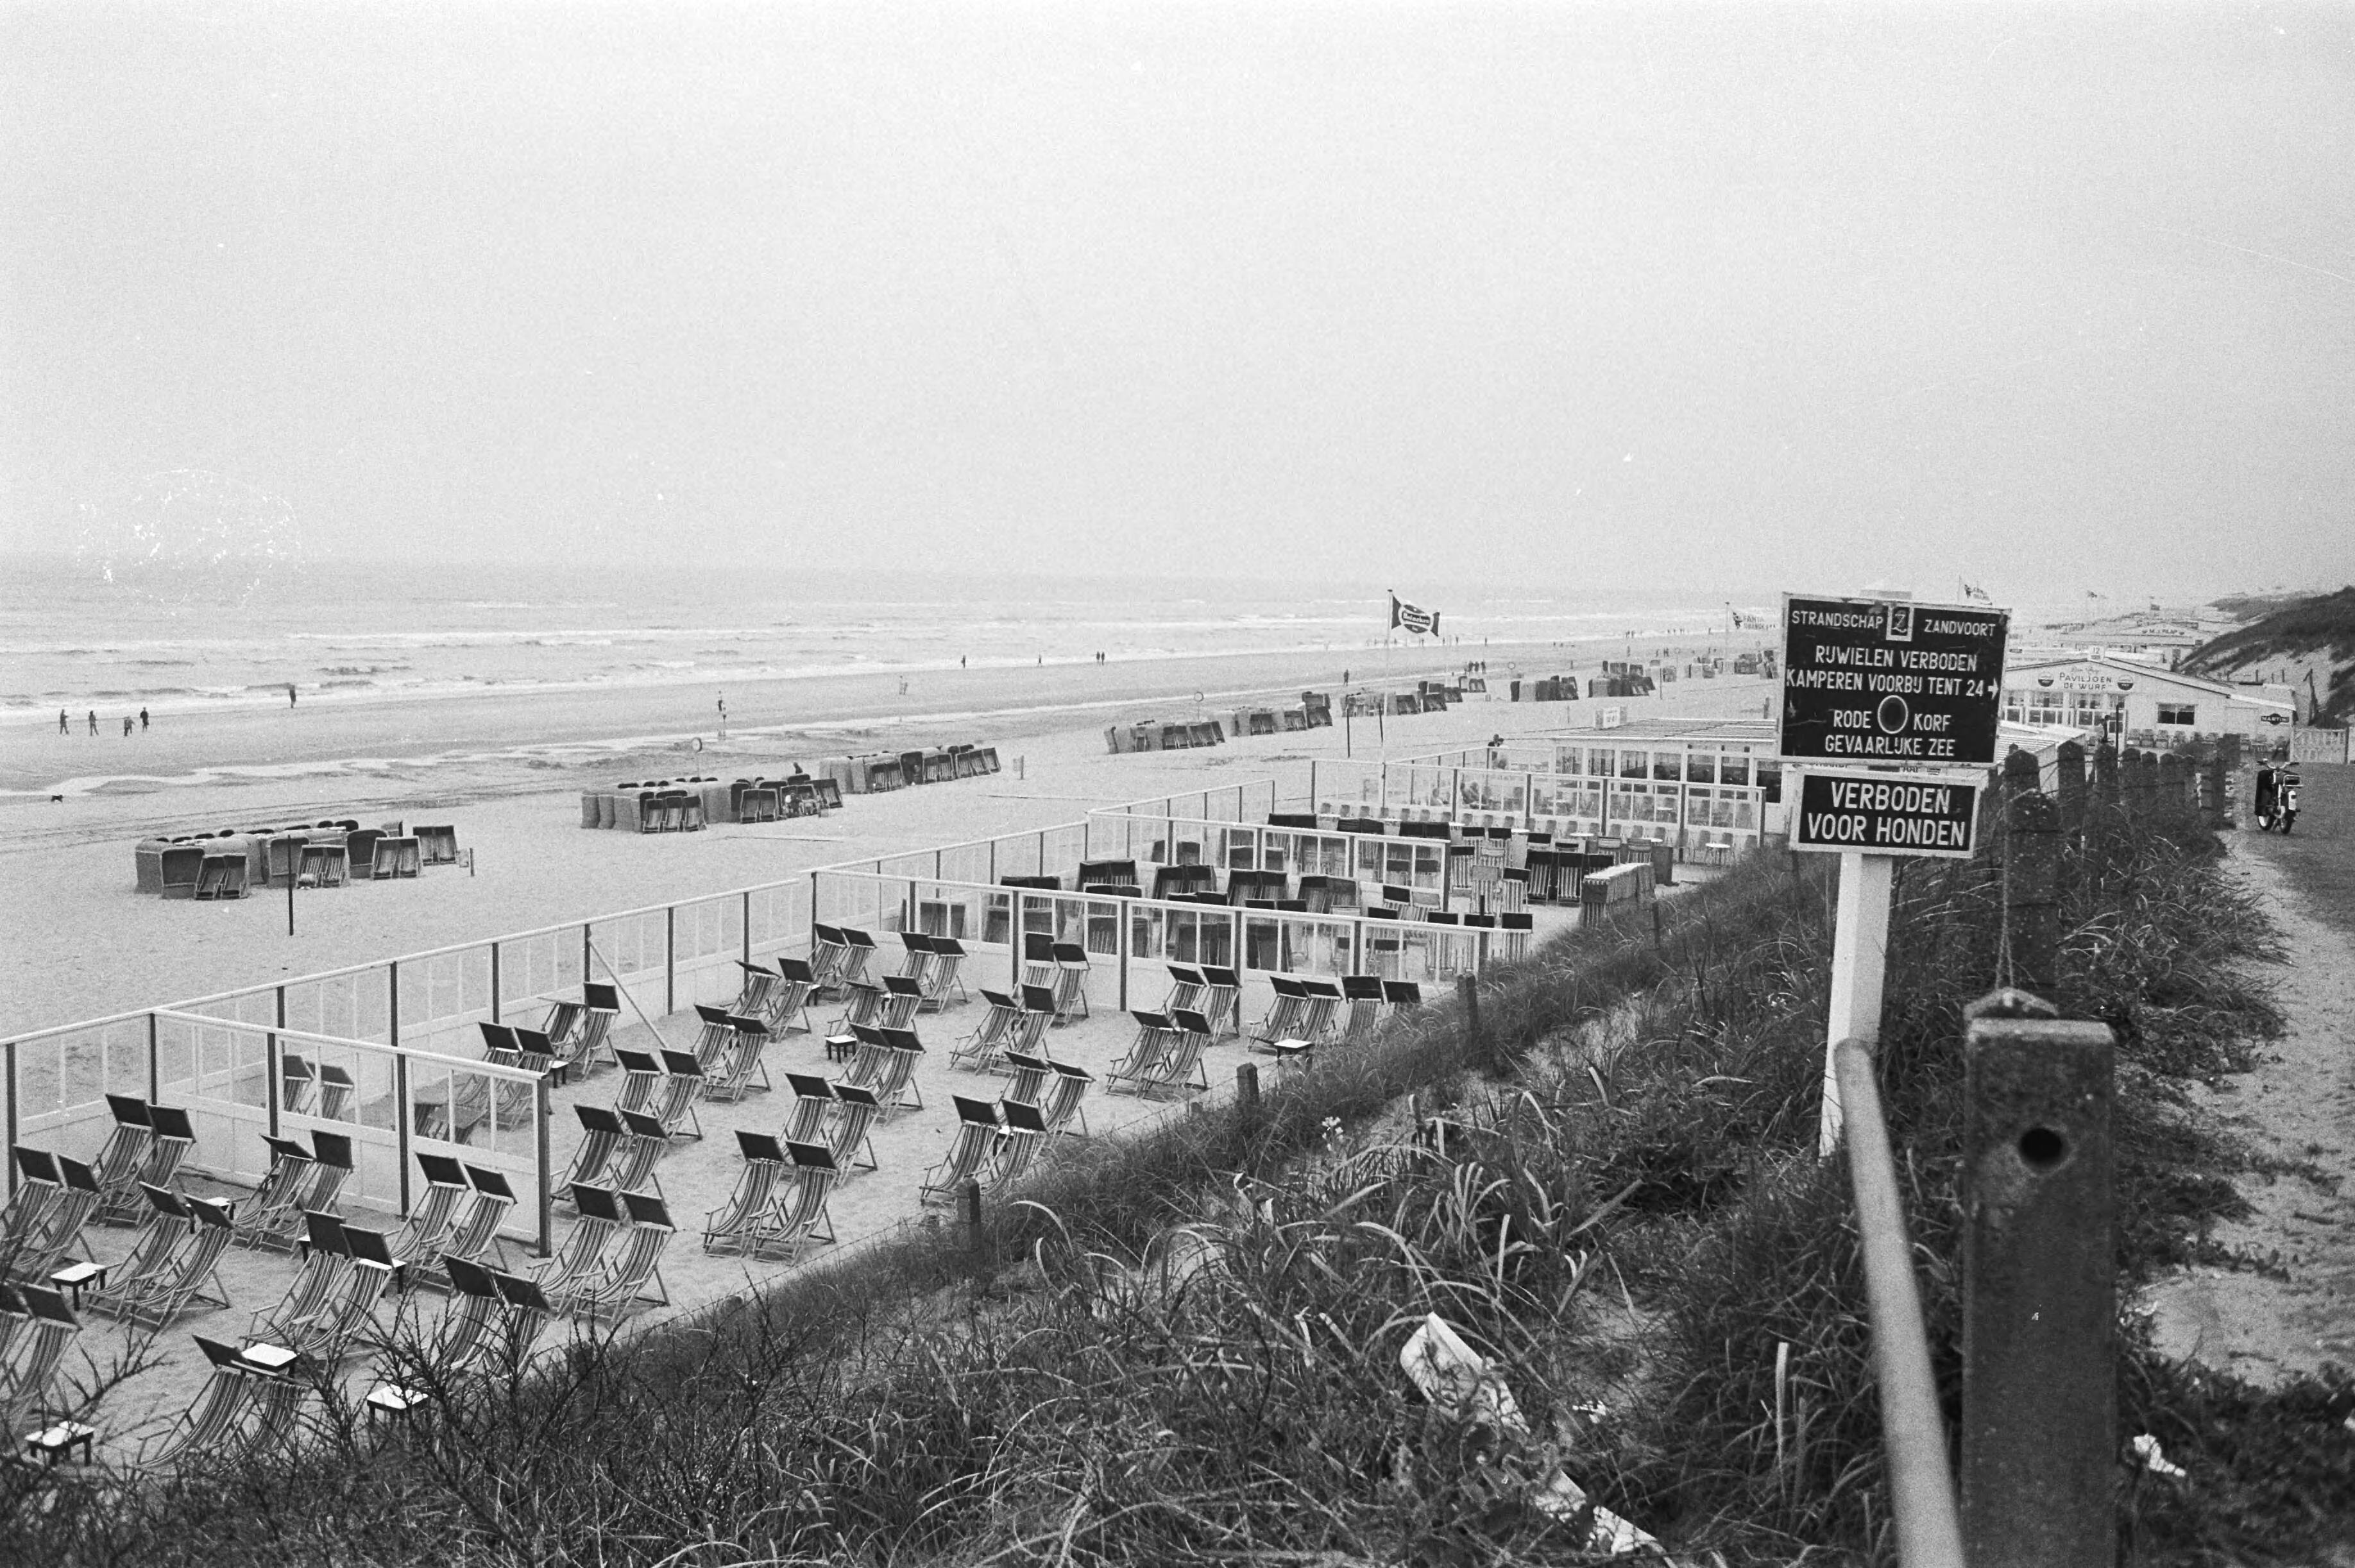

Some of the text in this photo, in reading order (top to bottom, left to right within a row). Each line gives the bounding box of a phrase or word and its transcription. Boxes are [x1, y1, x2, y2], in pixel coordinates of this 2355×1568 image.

[1792, 610, 1883, 629] STRANDSCHAP
[1925, 620, 1996, 636] ZANDVOORT
[1815, 645, 1977, 671] RIJWIELEN VERBODEN
[1787, 669, 1984, 696] KAMPEREN VOORBIJ TENT 24
[2059, 672, 2112, 683] PAVILJOEN
[1834, 710, 1951, 731] RODE KORF
[1825, 735, 1955, 756] GEVAARLIJKE ZEE
[1832, 781, 1951, 814] VERBODEN
[1808, 813, 1965, 847] VOOR HONDEN
